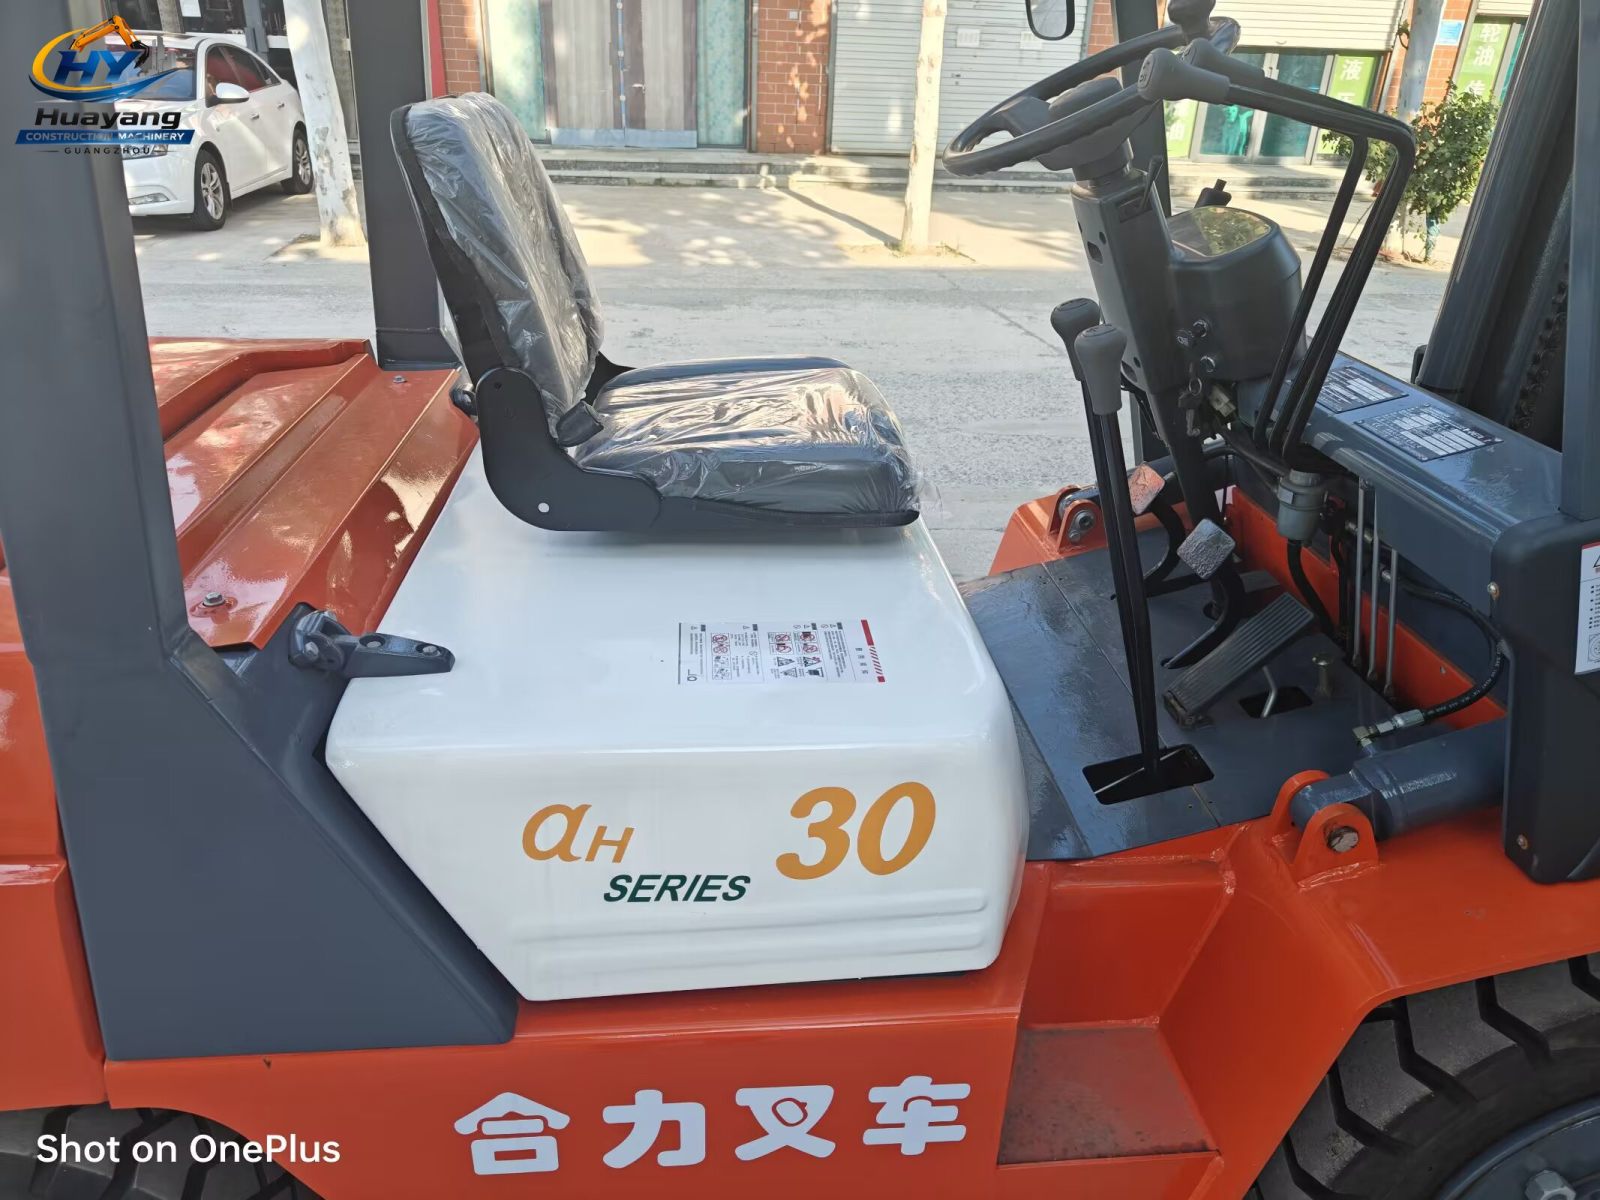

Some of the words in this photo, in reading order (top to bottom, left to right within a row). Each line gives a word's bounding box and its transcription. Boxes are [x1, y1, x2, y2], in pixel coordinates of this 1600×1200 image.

[777, 783, 935, 880] 30
[604, 875, 751, 903] SERIES
[455, 1076, 971, 1175] 合力叉车
